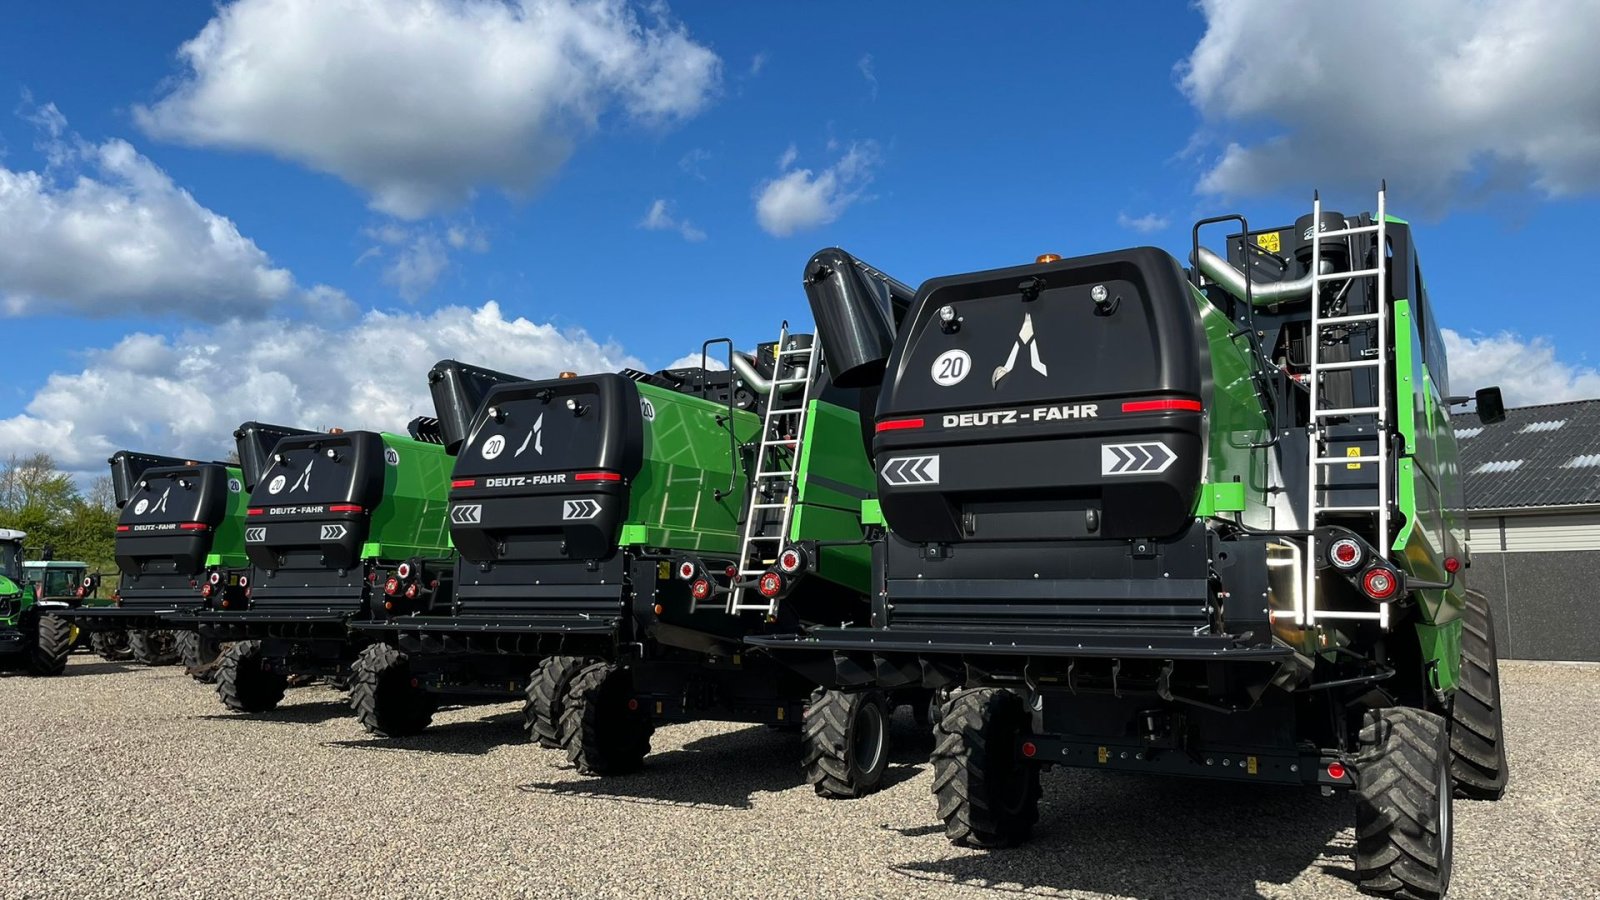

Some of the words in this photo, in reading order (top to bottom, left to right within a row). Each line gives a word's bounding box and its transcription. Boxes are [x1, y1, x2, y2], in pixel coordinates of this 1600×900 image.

[938, 357, 963, 379] 20
[641, 401, 653, 417] 20
[943, 404, 1098, 428] DEUTZ-FAHR
[486, 440, 502, 455] 20
[386, 451, 397, 463] 20
[231, 480, 240, 491] 20
[271, 479, 283, 490] 20
[486, 474, 566, 488] DEUTZ-FAHR
[270, 506, 323, 515] DEUTZ-FAHR
[134, 523, 176, 531] DEUTZ-FAHR
